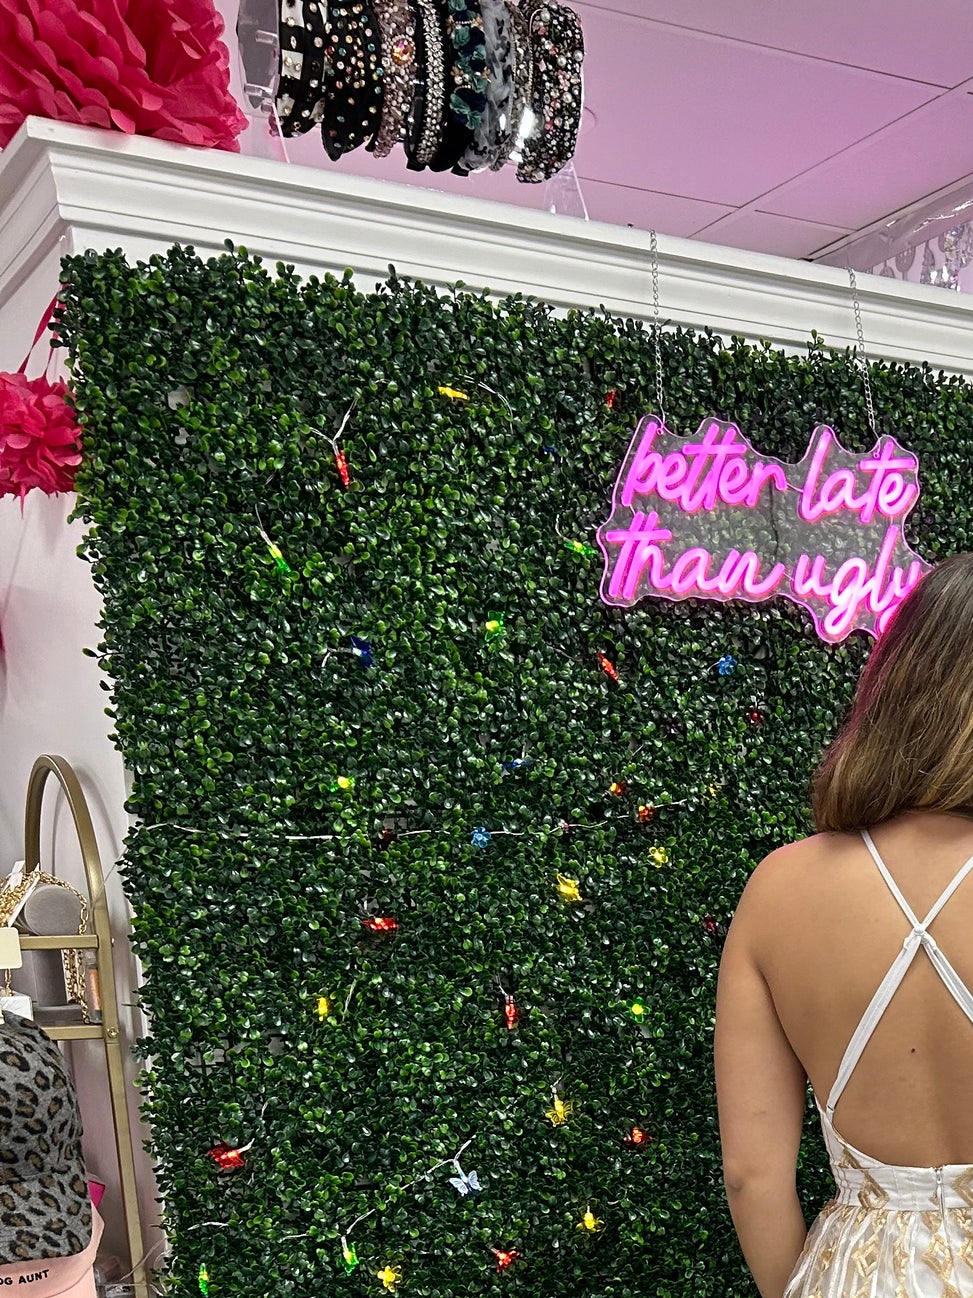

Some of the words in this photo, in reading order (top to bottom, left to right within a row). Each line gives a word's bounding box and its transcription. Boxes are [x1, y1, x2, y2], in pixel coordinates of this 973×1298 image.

[621, 421, 788, 513] better
[798, 429, 917, 523] late
[605, 511, 785, 600] than
[793, 524, 922, 637] ugly
[18, 1269, 49, 1284] AUNT
